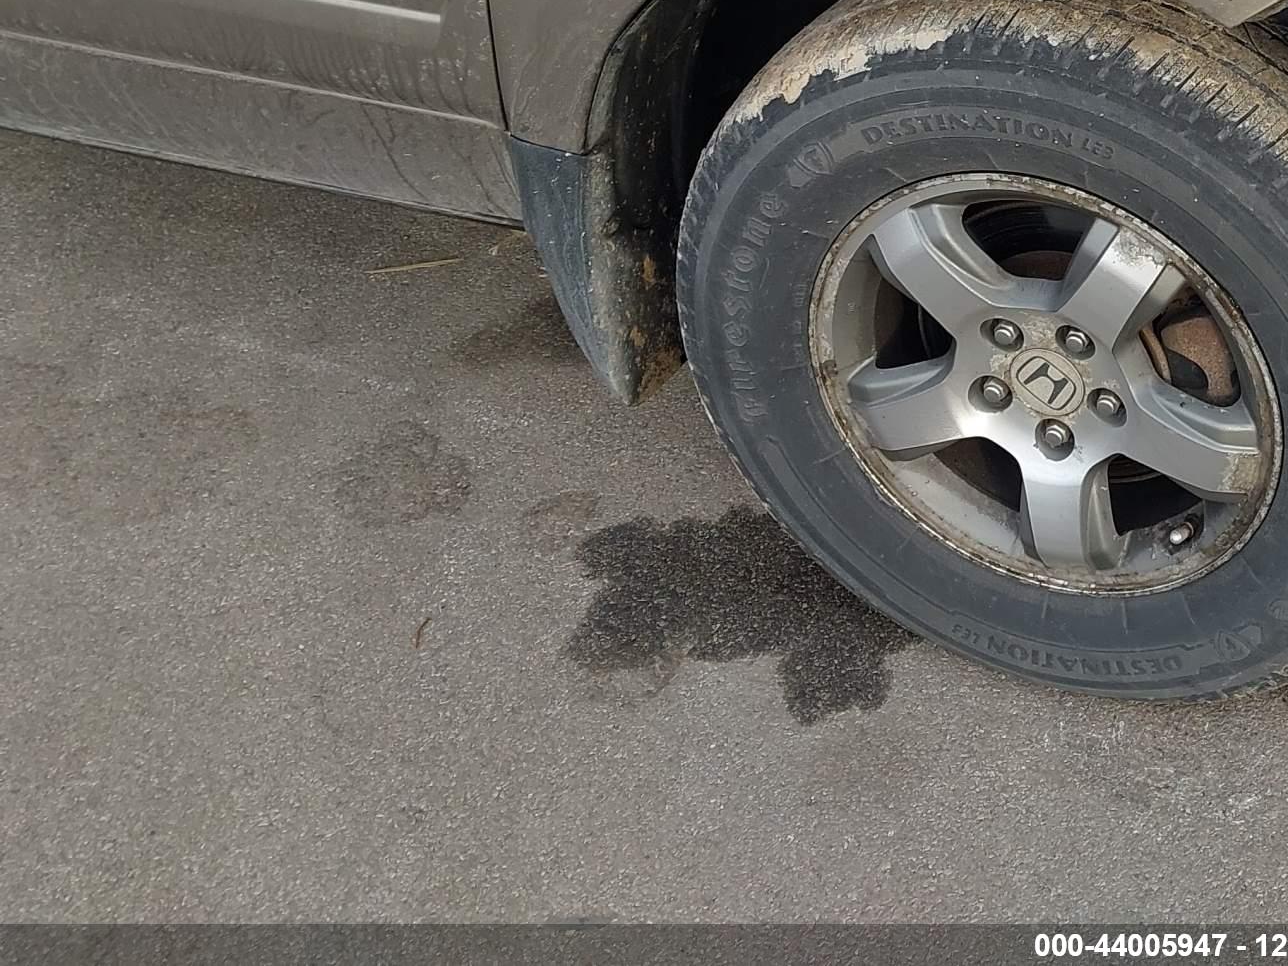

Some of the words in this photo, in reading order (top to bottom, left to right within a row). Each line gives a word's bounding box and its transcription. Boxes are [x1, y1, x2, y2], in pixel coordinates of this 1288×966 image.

[860, 112, 1074, 148] DESTINATION
[721, 192, 788, 423] Firestone
[986, 634, 1184, 676] DESTINATION
